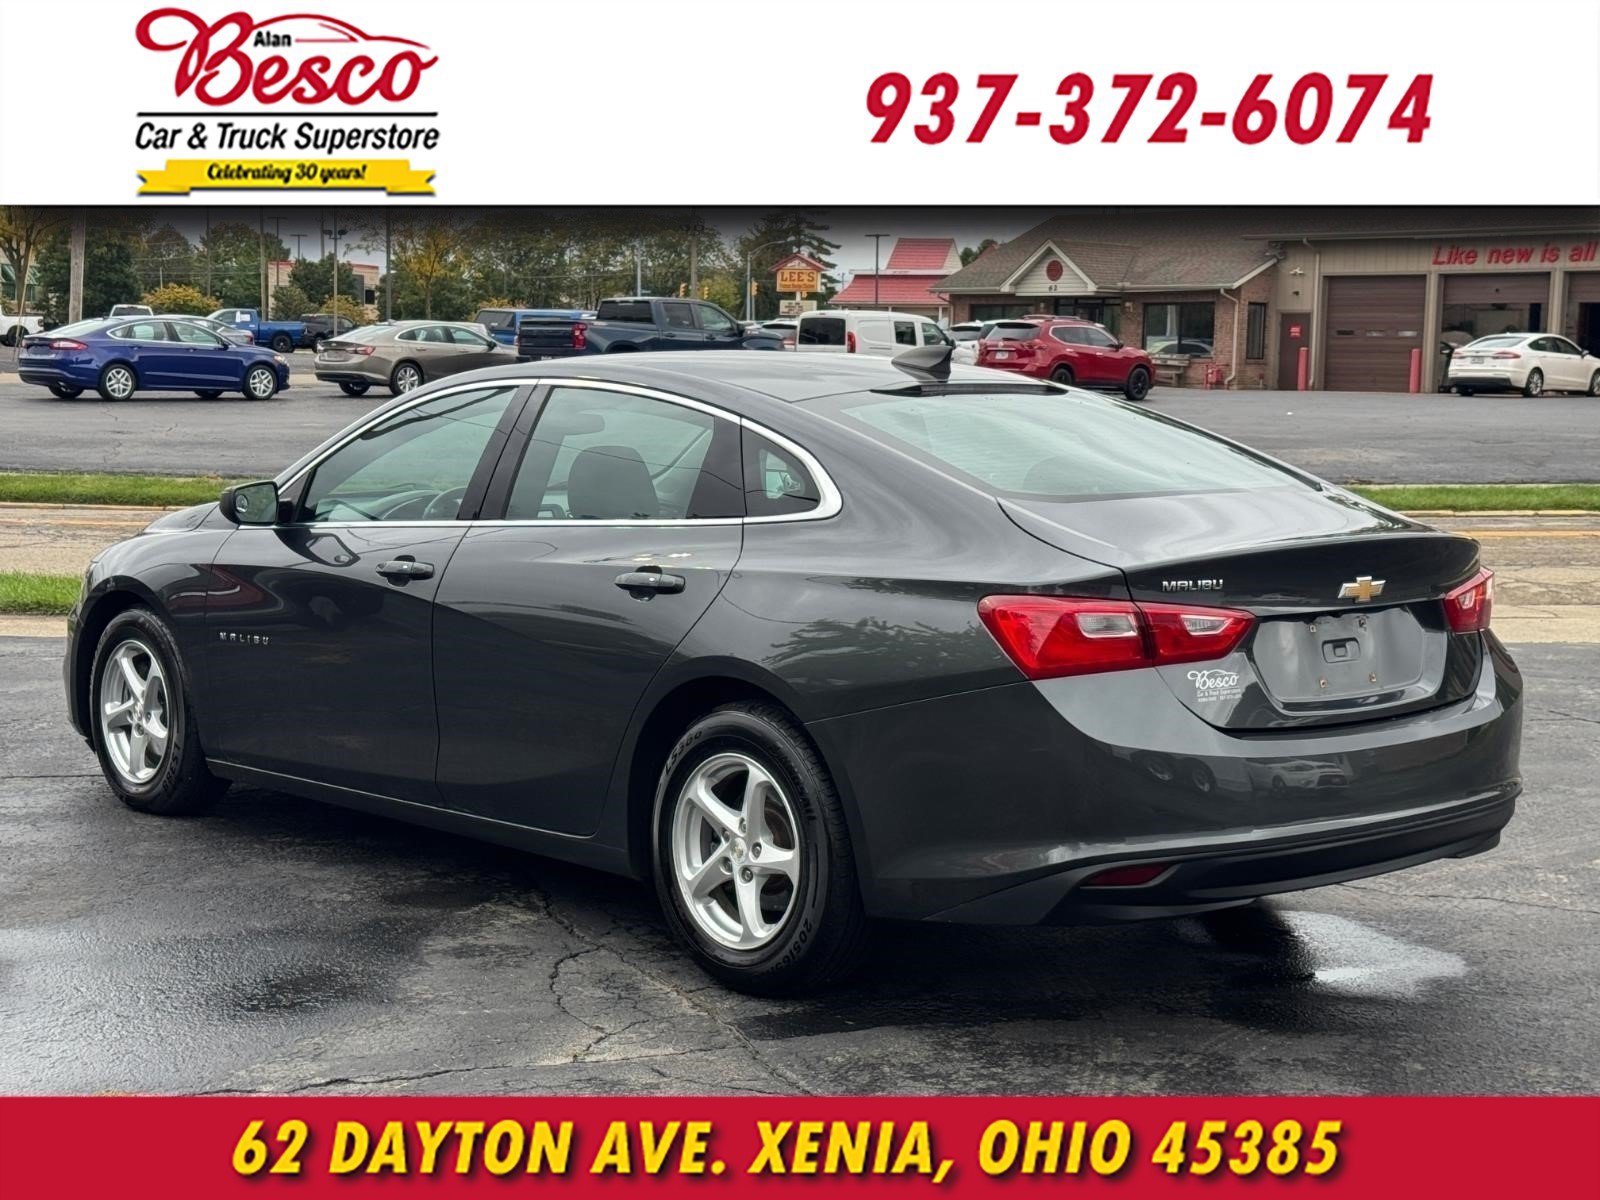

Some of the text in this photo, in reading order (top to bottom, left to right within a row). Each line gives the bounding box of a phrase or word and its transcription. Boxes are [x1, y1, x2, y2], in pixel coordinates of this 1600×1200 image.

[1432, 241, 1599, 266] Like new is all
[1161, 578, 1224, 592] MALIBU
[219, 631, 270, 646] MALIBU
[1187, 669, 1240, 690] Besco
